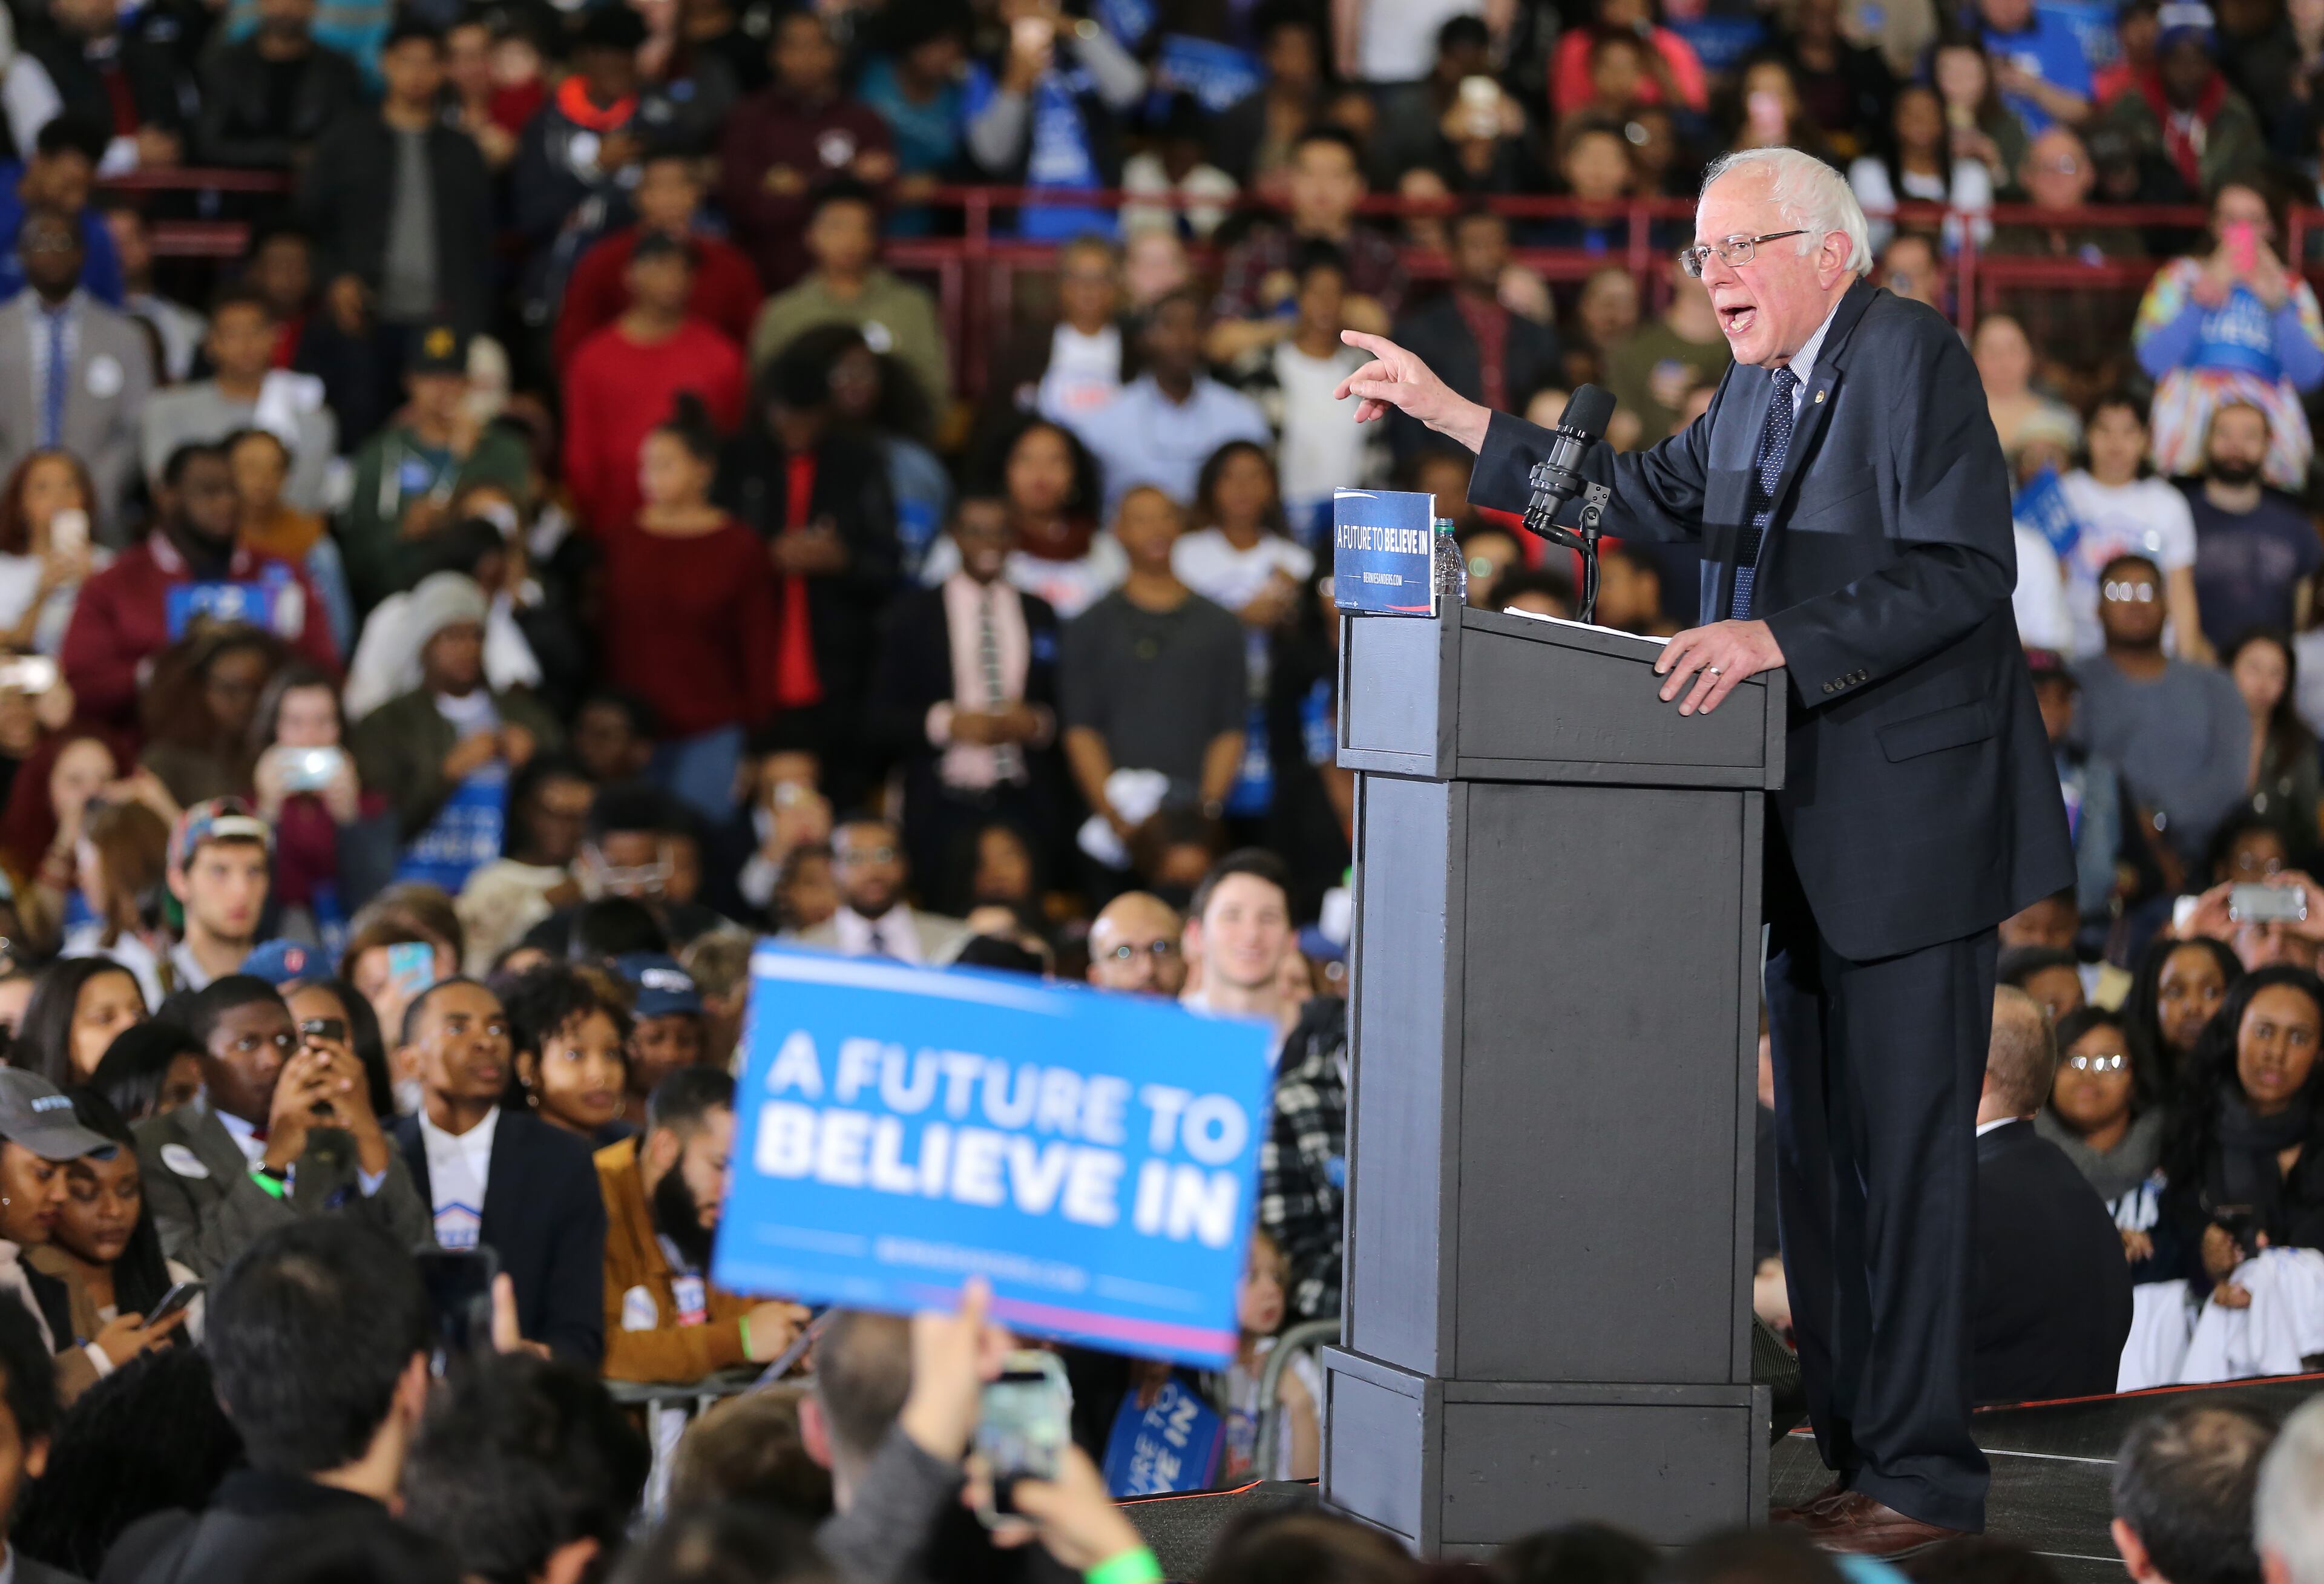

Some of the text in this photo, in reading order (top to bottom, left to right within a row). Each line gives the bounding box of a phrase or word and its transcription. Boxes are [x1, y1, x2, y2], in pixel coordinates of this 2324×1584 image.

[1336, 524, 1428, 556] A FUTURE TO BELIEVE IN
[1363, 571, 1402, 587] BERNIESANDERS.COM
[765, 1029, 1249, 1166] A FUTURE TO
[753, 1099, 1239, 1249] BELIEVE IN
[1142, 1383, 1178, 1428] TO
[1163, 1395, 1200, 1449] IN
